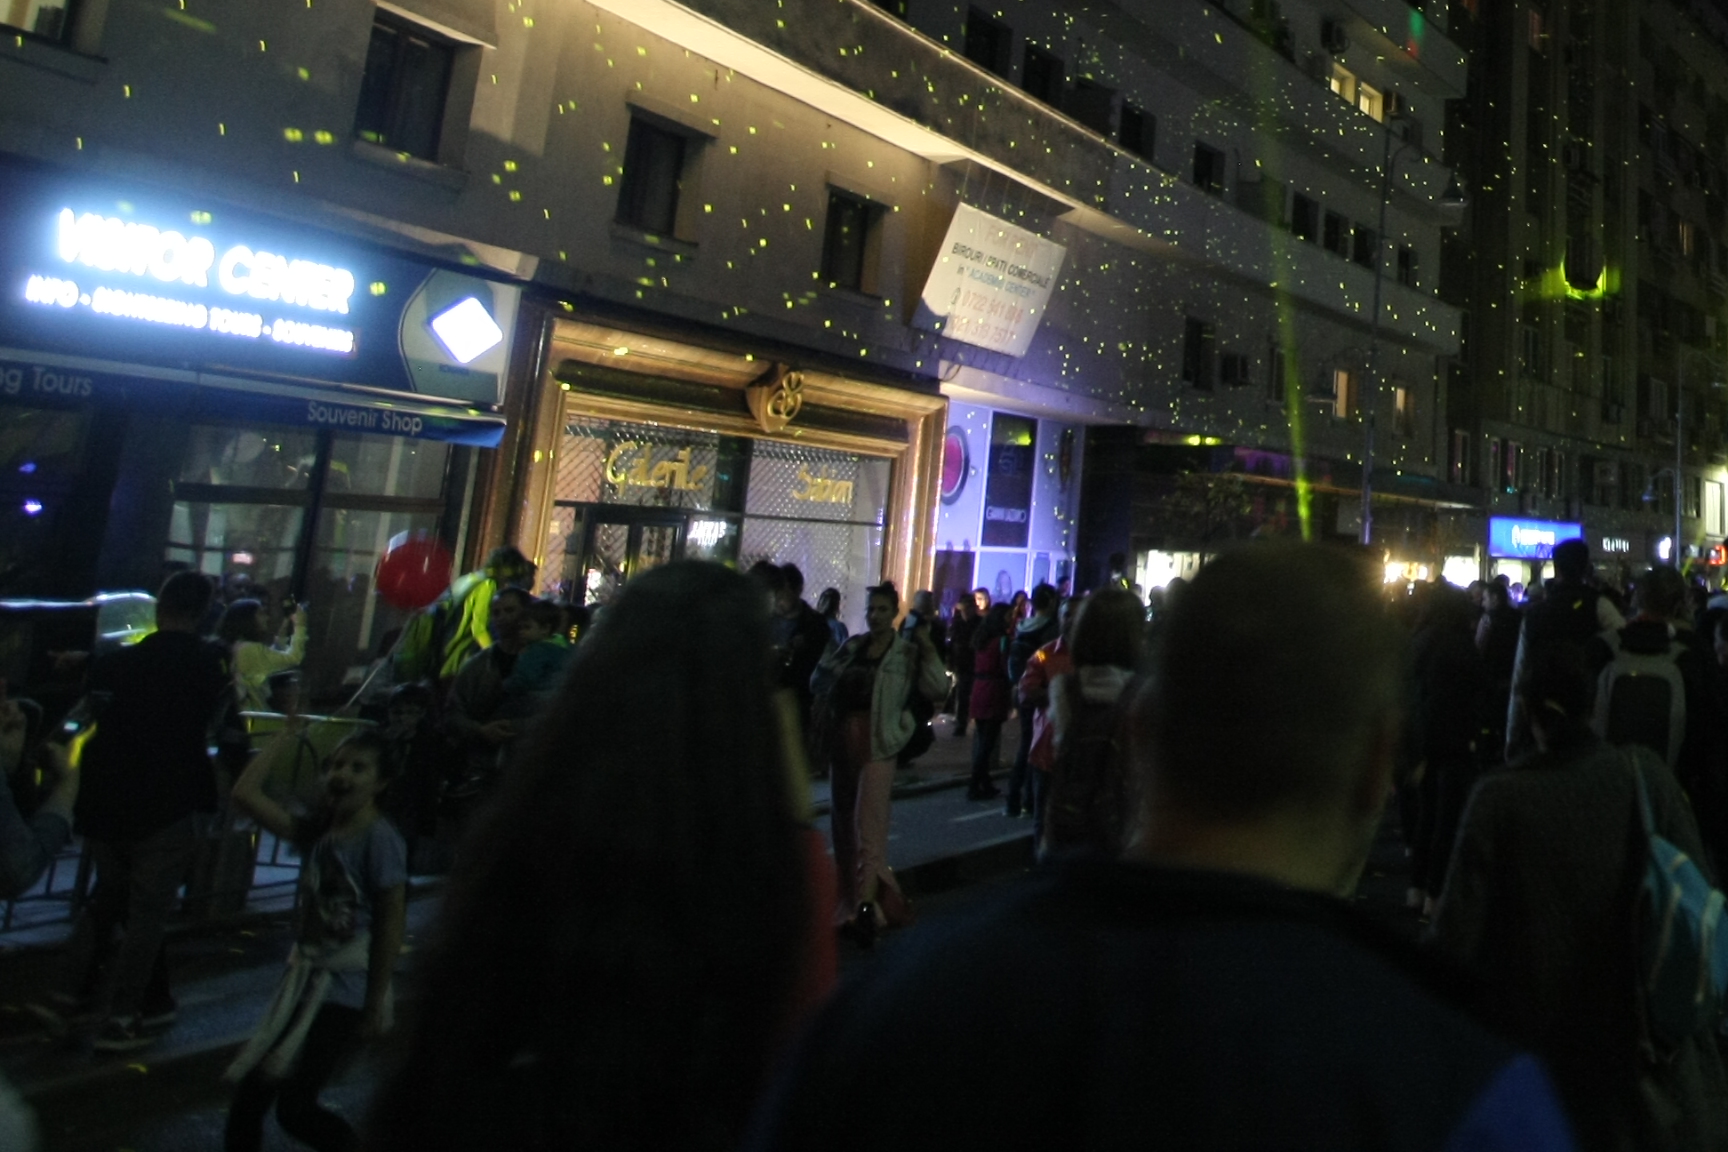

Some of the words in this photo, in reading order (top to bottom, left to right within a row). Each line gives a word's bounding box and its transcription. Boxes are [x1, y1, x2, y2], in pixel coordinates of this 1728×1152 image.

[219, 245, 354, 314] CENTER
[32, 365, 93, 397] Tours
[307, 400, 379, 428] Souvenir
[381, 410, 423, 436] Shop
